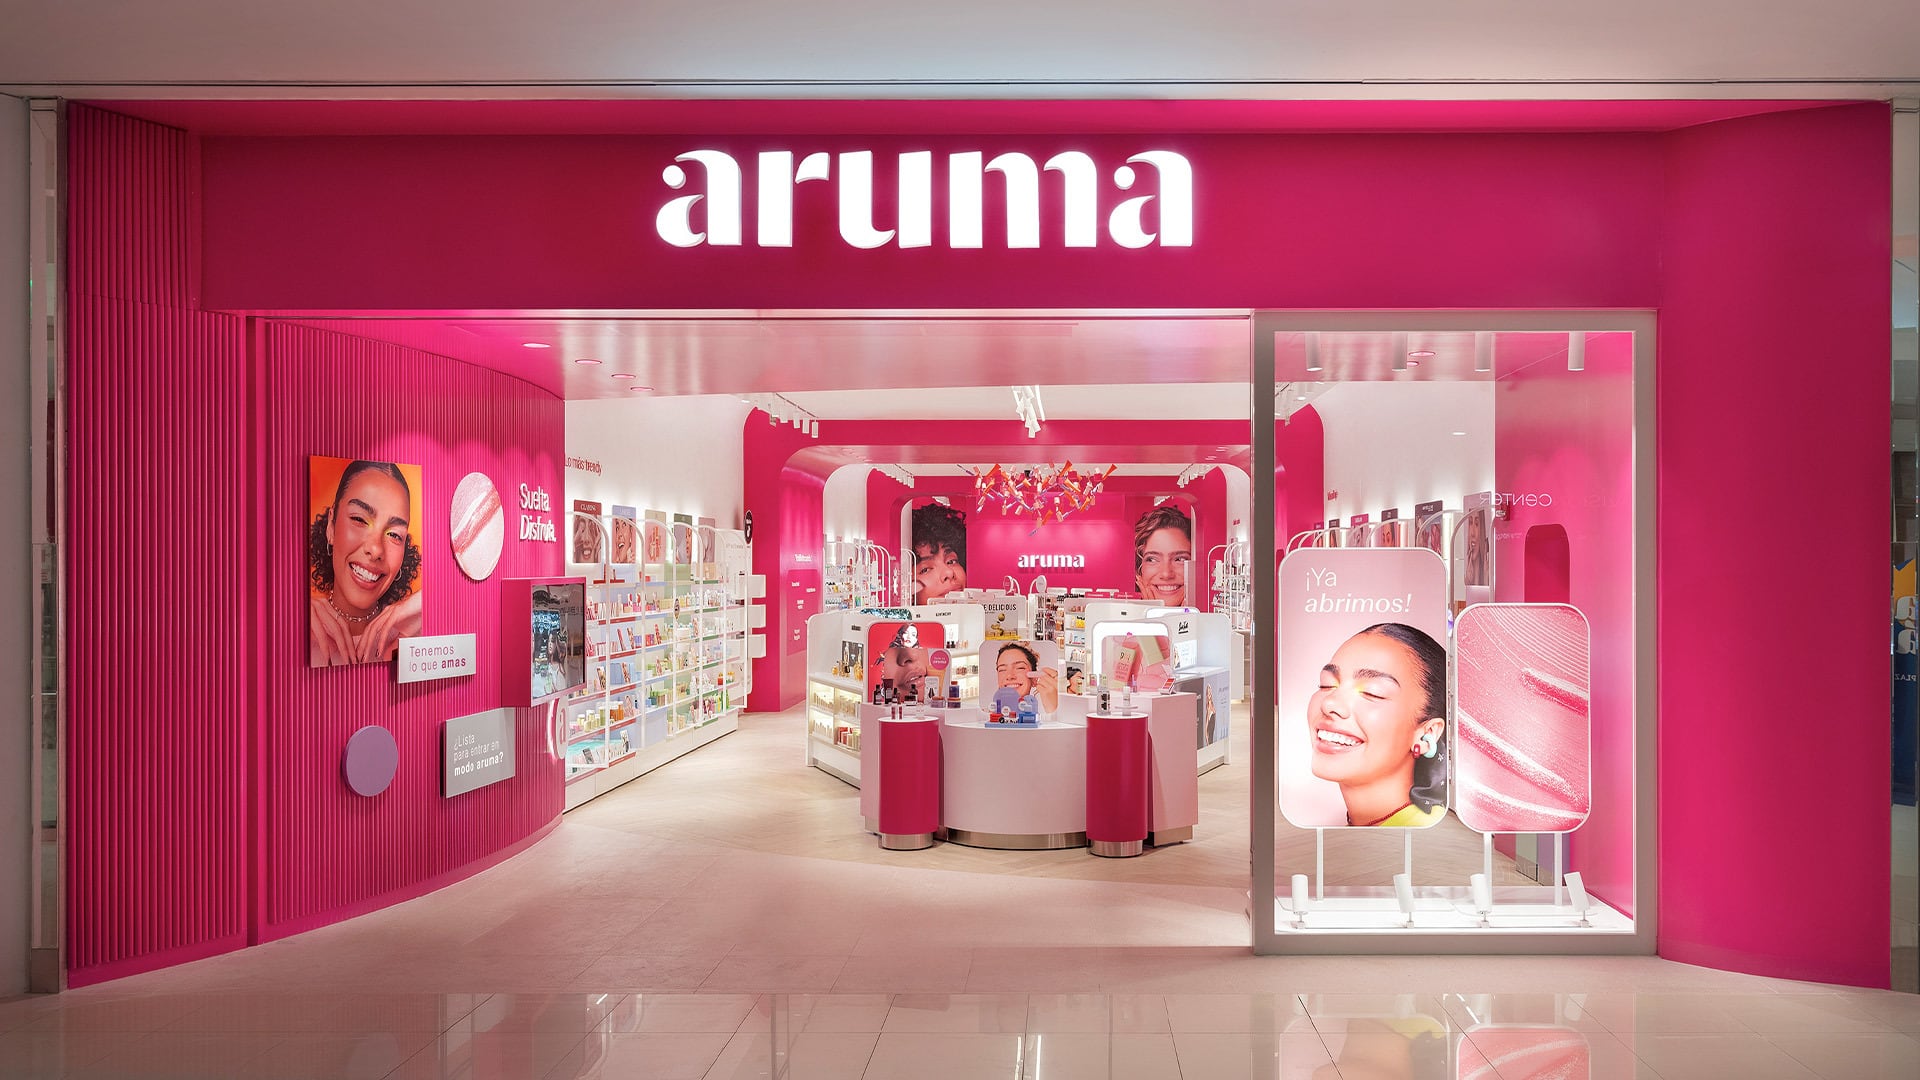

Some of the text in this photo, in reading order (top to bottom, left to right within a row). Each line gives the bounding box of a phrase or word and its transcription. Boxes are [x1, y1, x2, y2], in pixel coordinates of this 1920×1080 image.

[655, 150, 1193, 249] aruma
[1017, 554, 1085, 568] aruma
[1306, 567, 1337, 592] ¡Ya
[1304, 593, 1412, 613] abrimos!
[409, 646, 455, 657] Tenemos
[409, 657, 466, 673] lo que amas
[453, 734, 475, 751] ¿Lista
[453, 749, 469, 764] para
[471, 743, 490, 757] entrar
[454, 751, 504, 777] modo aruma?
